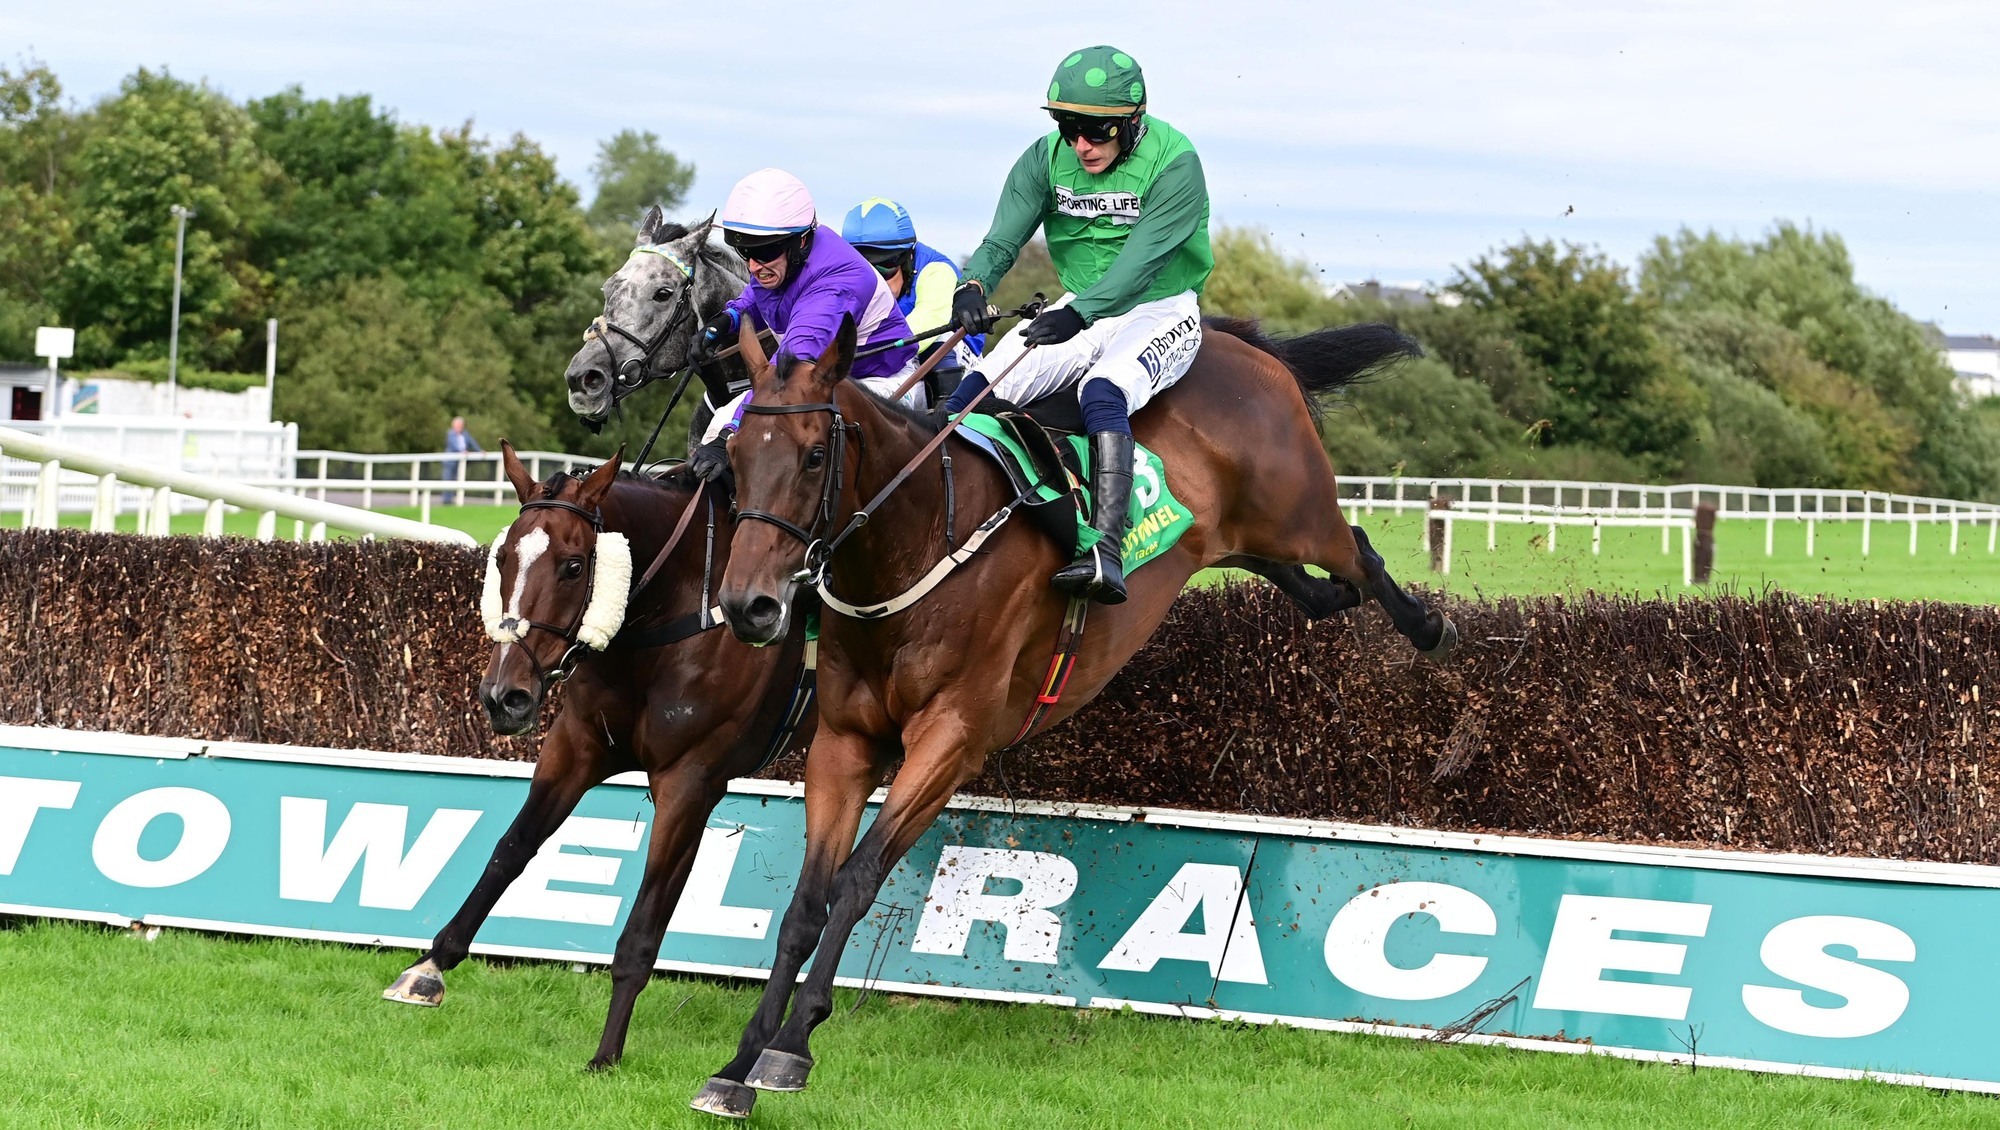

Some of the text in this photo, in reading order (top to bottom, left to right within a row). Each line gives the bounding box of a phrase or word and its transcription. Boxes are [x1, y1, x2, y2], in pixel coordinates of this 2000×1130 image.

[1057, 193, 1139, 211] SPORTING LIFE
[1151, 315, 1197, 356] Brown
[1135, 541, 1159, 561] races
[911, 846, 1915, 1038] RACES
